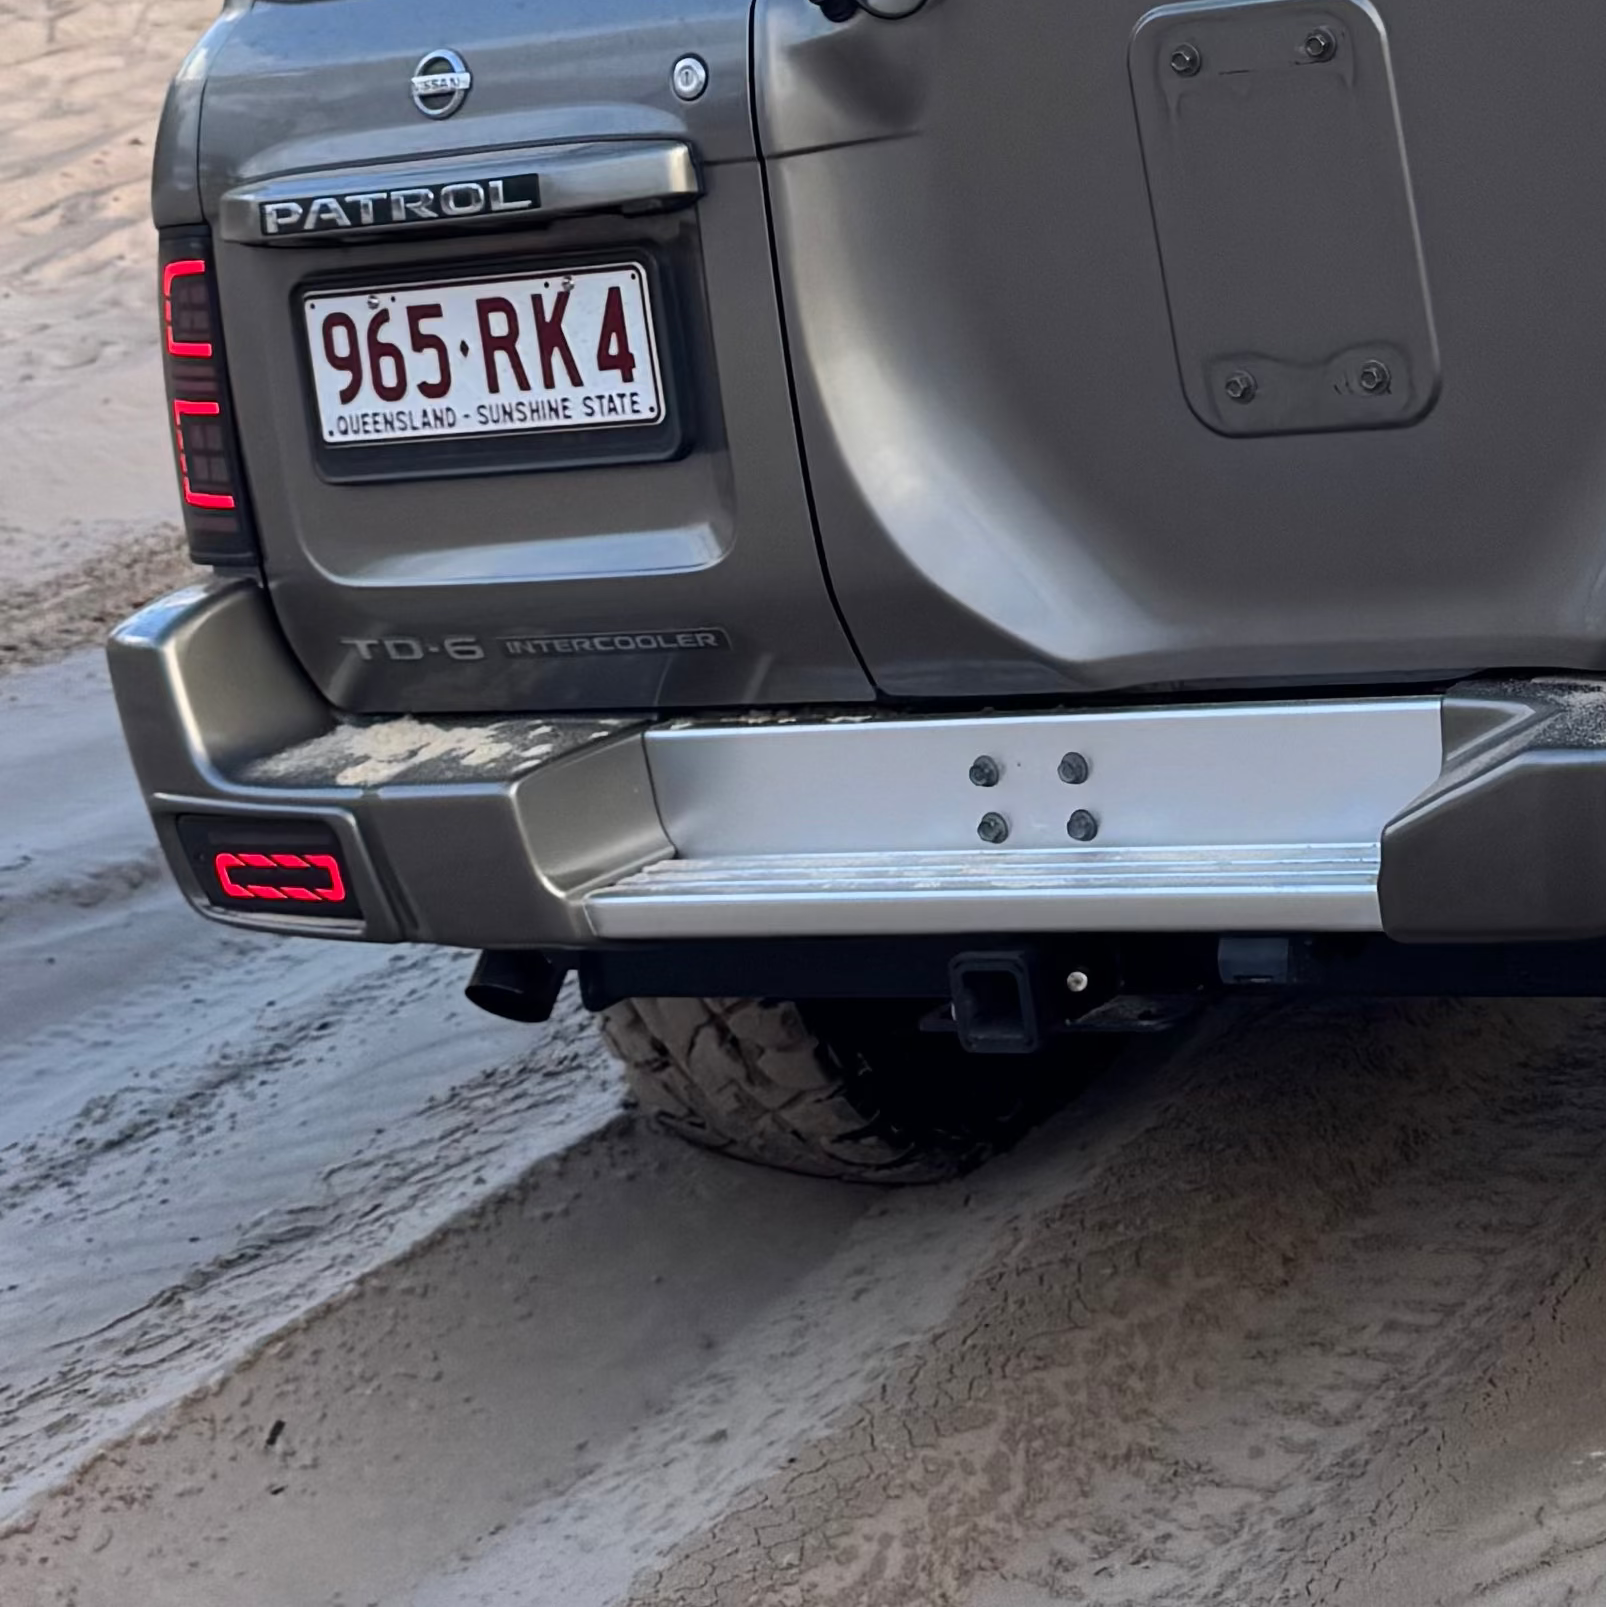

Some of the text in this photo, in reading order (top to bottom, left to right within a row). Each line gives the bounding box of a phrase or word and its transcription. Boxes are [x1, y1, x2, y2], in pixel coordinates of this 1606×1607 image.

[264, 179, 532, 233] PATROL
[336, 406, 457, 436] QUEENSLAND
[478, 396, 573, 427] SUNSHINE
[582, 392, 641, 417] STATE
[505, 633, 719, 654] INTERCOOLER
